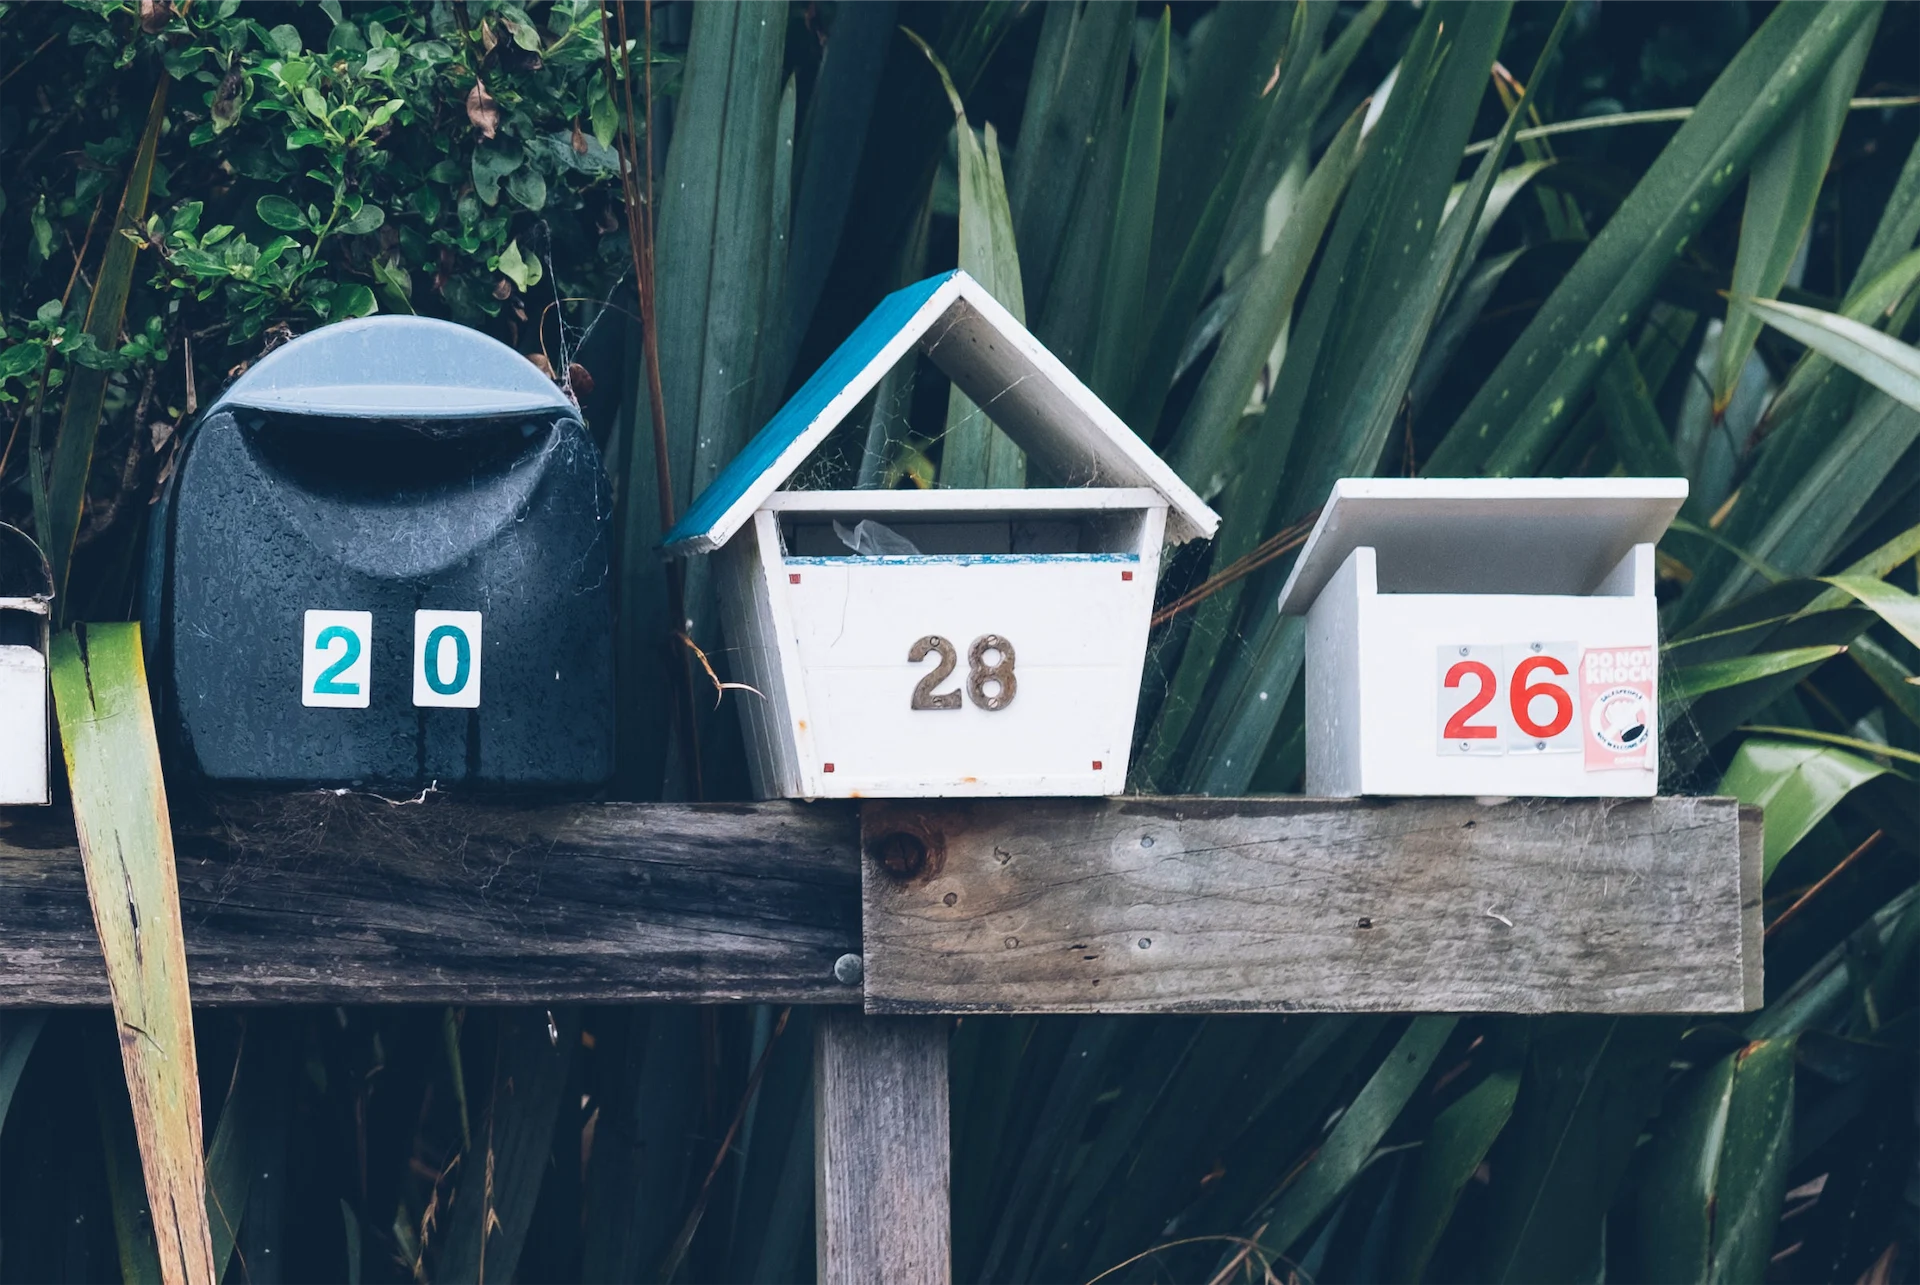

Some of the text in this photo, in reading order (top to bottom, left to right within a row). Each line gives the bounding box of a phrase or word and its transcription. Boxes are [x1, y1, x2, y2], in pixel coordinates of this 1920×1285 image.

[907, 633, 1018, 711] 28
[1586, 649, 1652, 668] DO NOT
[1586, 666, 1653, 683] KNOCK
[1443, 655, 1573, 739] 26
